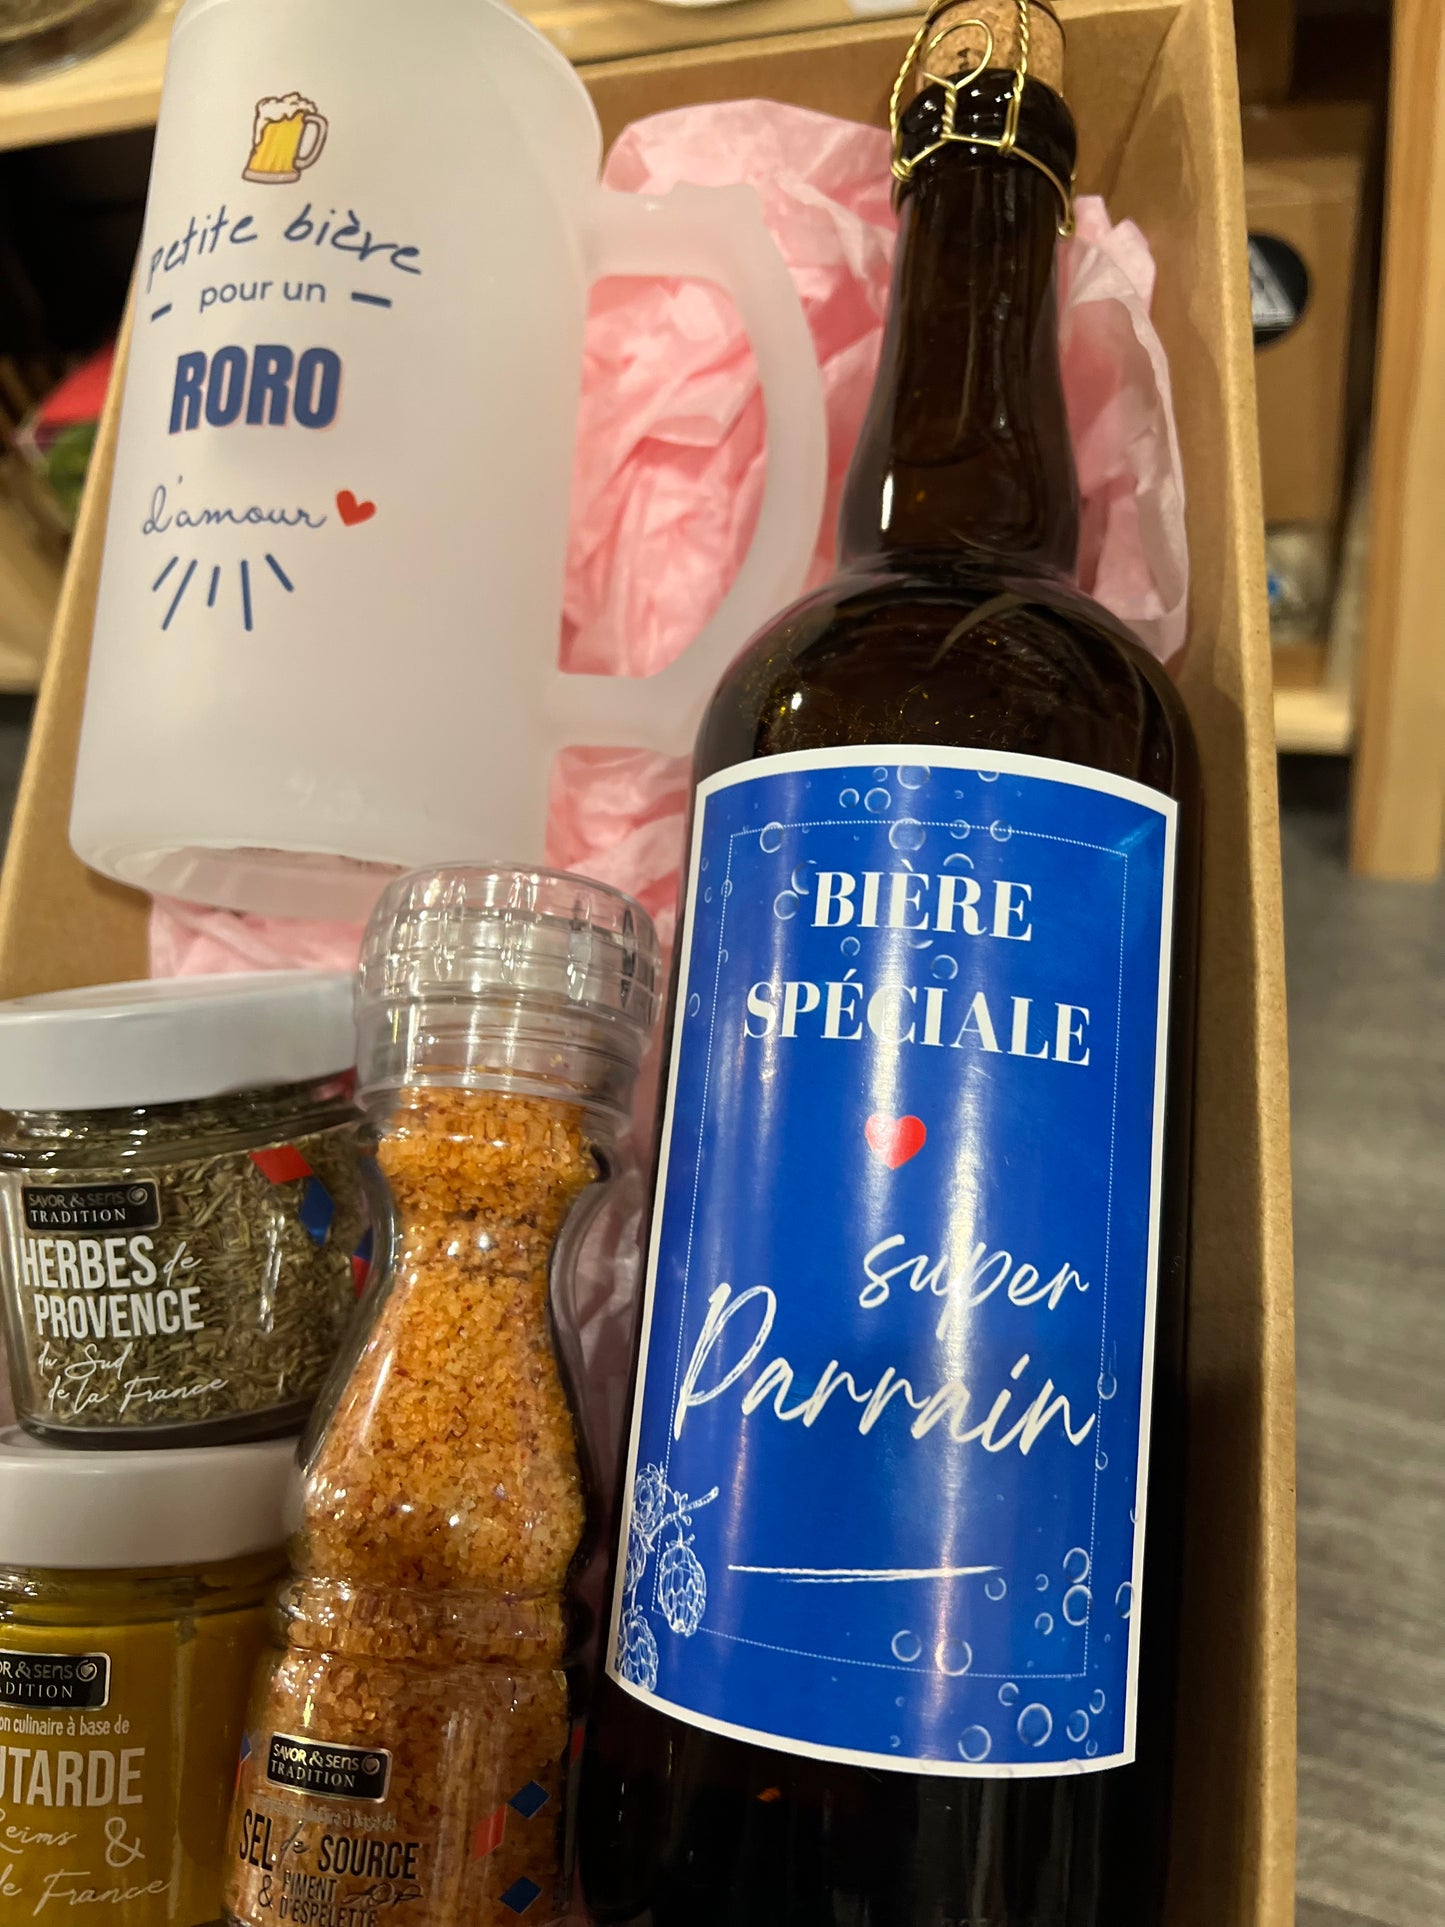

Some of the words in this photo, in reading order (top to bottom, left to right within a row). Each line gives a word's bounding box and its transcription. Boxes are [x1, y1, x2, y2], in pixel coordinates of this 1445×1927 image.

[147, 205, 257, 293] petite
[284, 203, 421, 275] bière
[199, 281, 273, 313] pour
[283, 281, 326, 302] un
[169, 345, 345, 435] RORO
[143, 475, 327, 535] d'amour
[811, 860, 1032, 941] BIÈRE
[743, 969, 1091, 1066] SPÉCIALE
[28, 1193, 67, 1208] SAVOR
[70, 1192, 85, 1208] &
[31, 1208, 126, 1223] TRADITION
[20, 1236, 157, 1289] HERBES
[163, 1241, 202, 1287] de
[860, 1234, 1089, 1338] super
[34, 1287, 204, 1338] PROVENCE
[64, 1342, 133, 1380] Sud
[674, 1282, 1096, 1455] Parrain
[119, 1375, 229, 1413] France
[15, 1661, 31, 1679] &
[13, 1713, 63, 1736] culinaire
[66, 1716, 76, 1737] à
[79, 1716, 111, 1736] base
[114, 1714, 130, 1735] de
[270, 1760, 355, 1788] TRADITION
[273, 1743, 307, 1767] SAVOR
[308, 1750, 324, 1768] &
[104, 1816, 146, 1868] &
[239, 1808, 274, 1871] SEL
[317, 1834, 421, 1880] SOURCE
[32, 1868, 172, 1916] France
[257, 1874, 274, 1910] &
[282, 1870, 338, 1902] PIMENT
